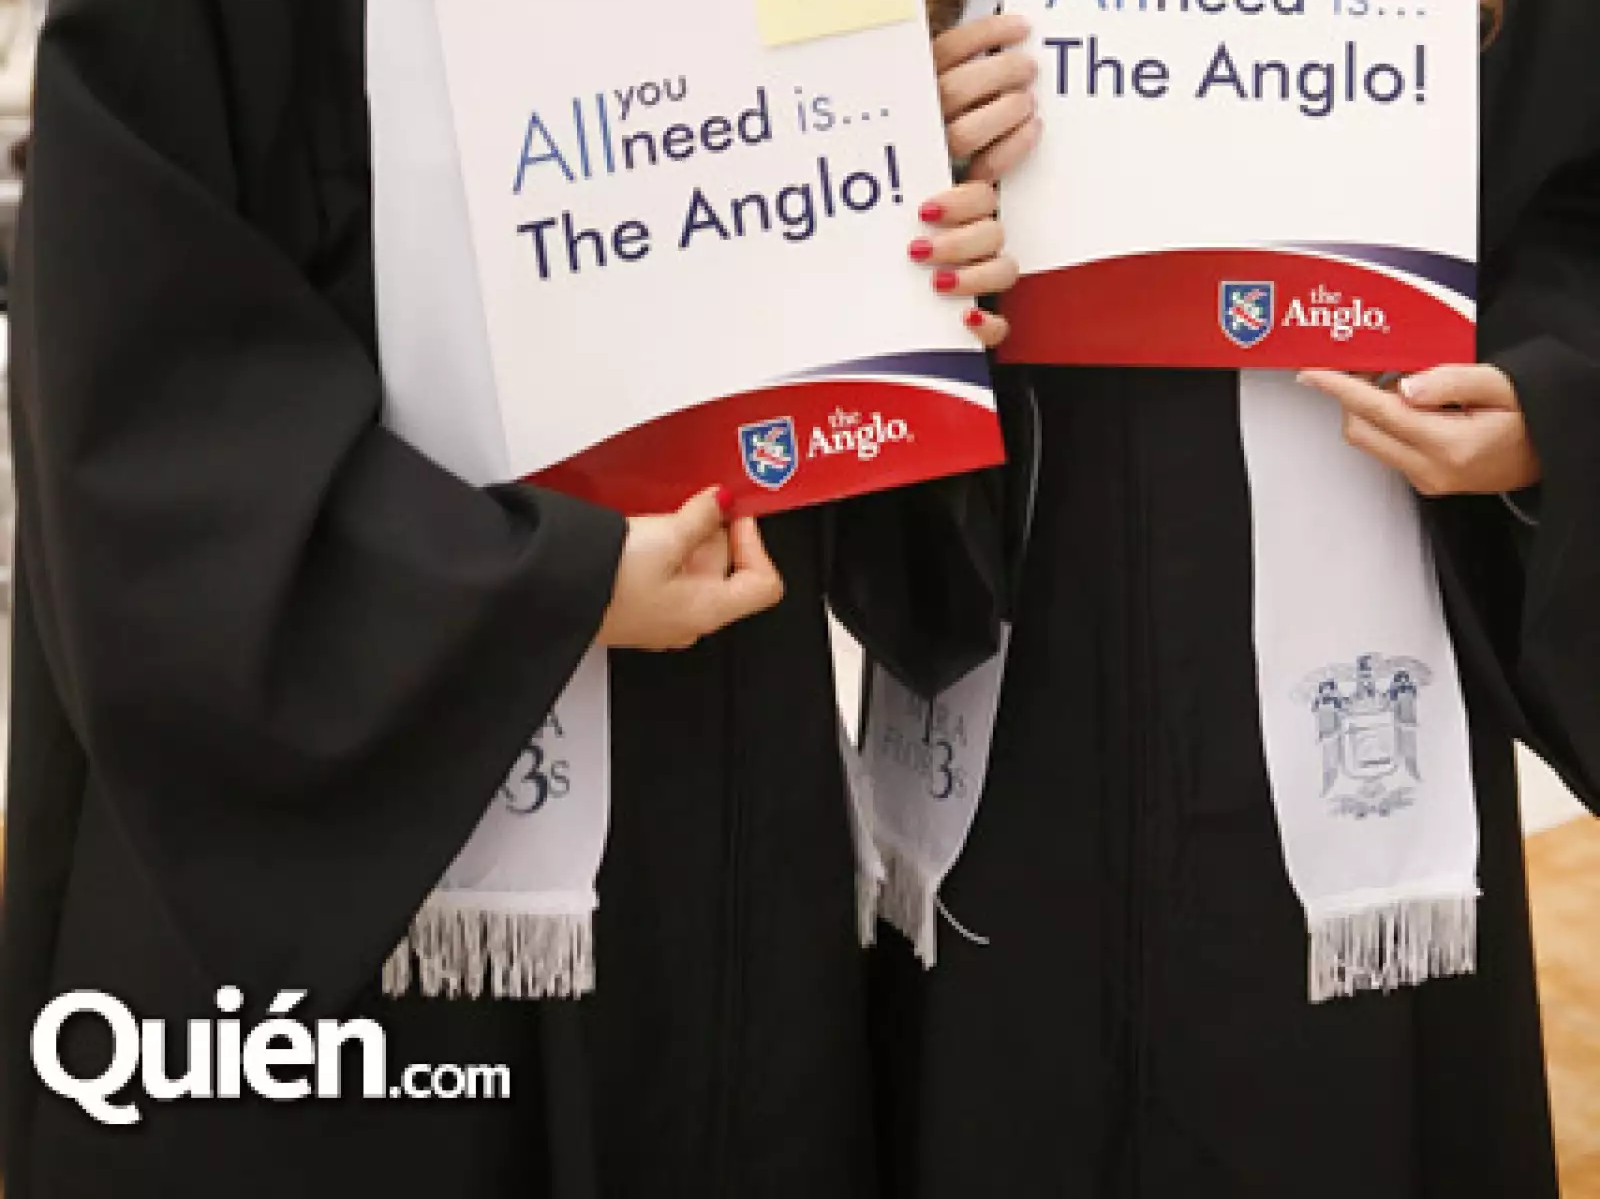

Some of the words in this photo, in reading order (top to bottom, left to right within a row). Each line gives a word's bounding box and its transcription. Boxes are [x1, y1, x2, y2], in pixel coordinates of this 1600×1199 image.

[613, 74, 688, 121] you
[1042, 33, 1171, 99] The
[1194, 39, 1428, 118] Anglo!
[512, 92, 616, 196] All
[620, 85, 774, 171] need
[515, 209, 652, 281] The
[677, 143, 904, 250] Anglo!
[1309, 282, 1343, 305] the
[827, 404, 863, 428] the
